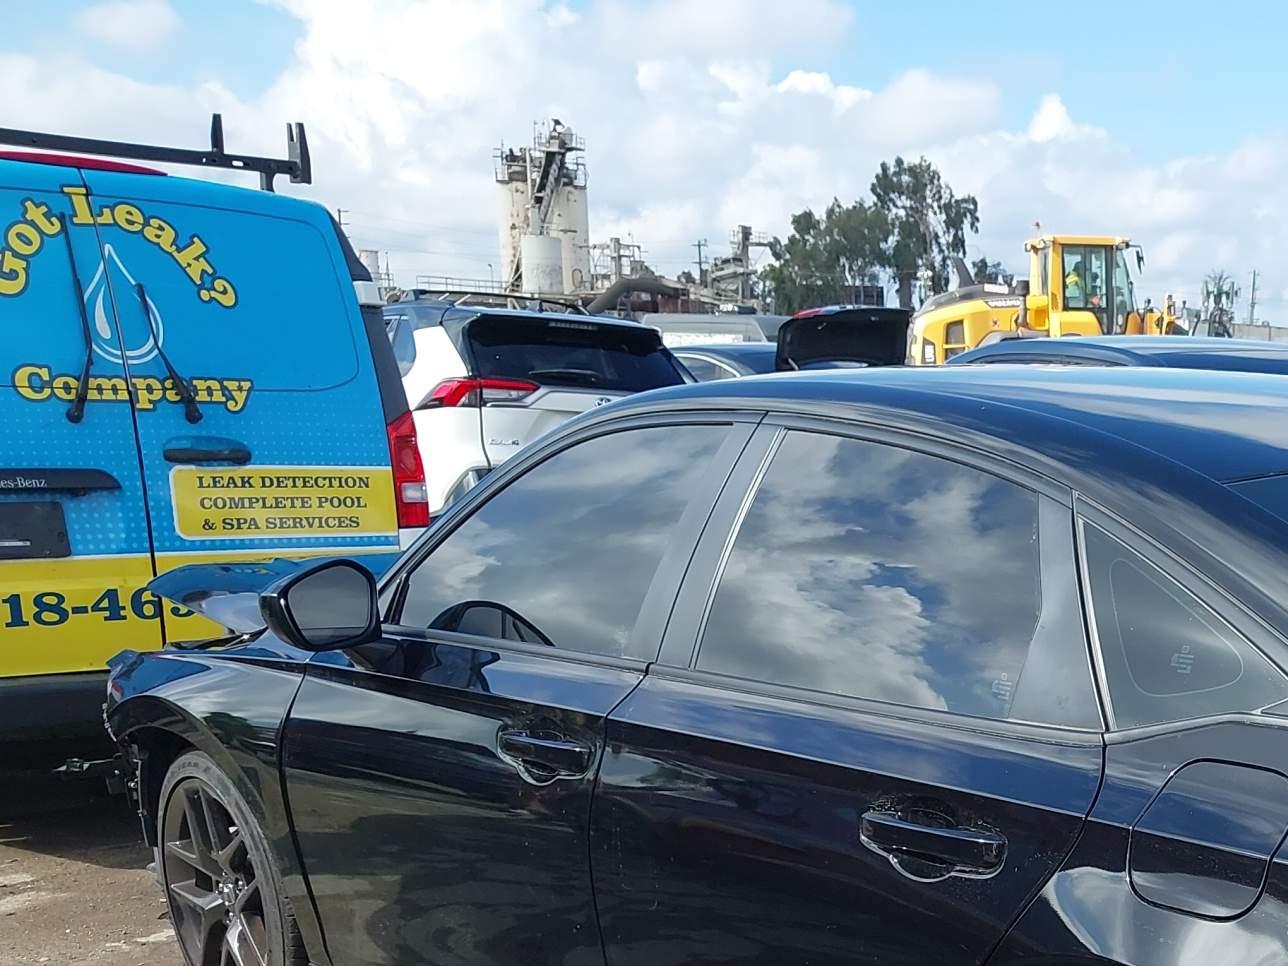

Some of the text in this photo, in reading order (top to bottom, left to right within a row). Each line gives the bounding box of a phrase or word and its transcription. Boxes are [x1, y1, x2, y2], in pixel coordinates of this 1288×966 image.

[0, 186, 236, 307] Got Leak?
[14, 366, 252, 412] Company
[0, 476, 48, 489] es-Benz
[197, 475, 370, 489] LEAK DETECTION
[200, 496, 368, 510] COMPLETE POOL
[202, 516, 360, 531] & SPA SERVICES
